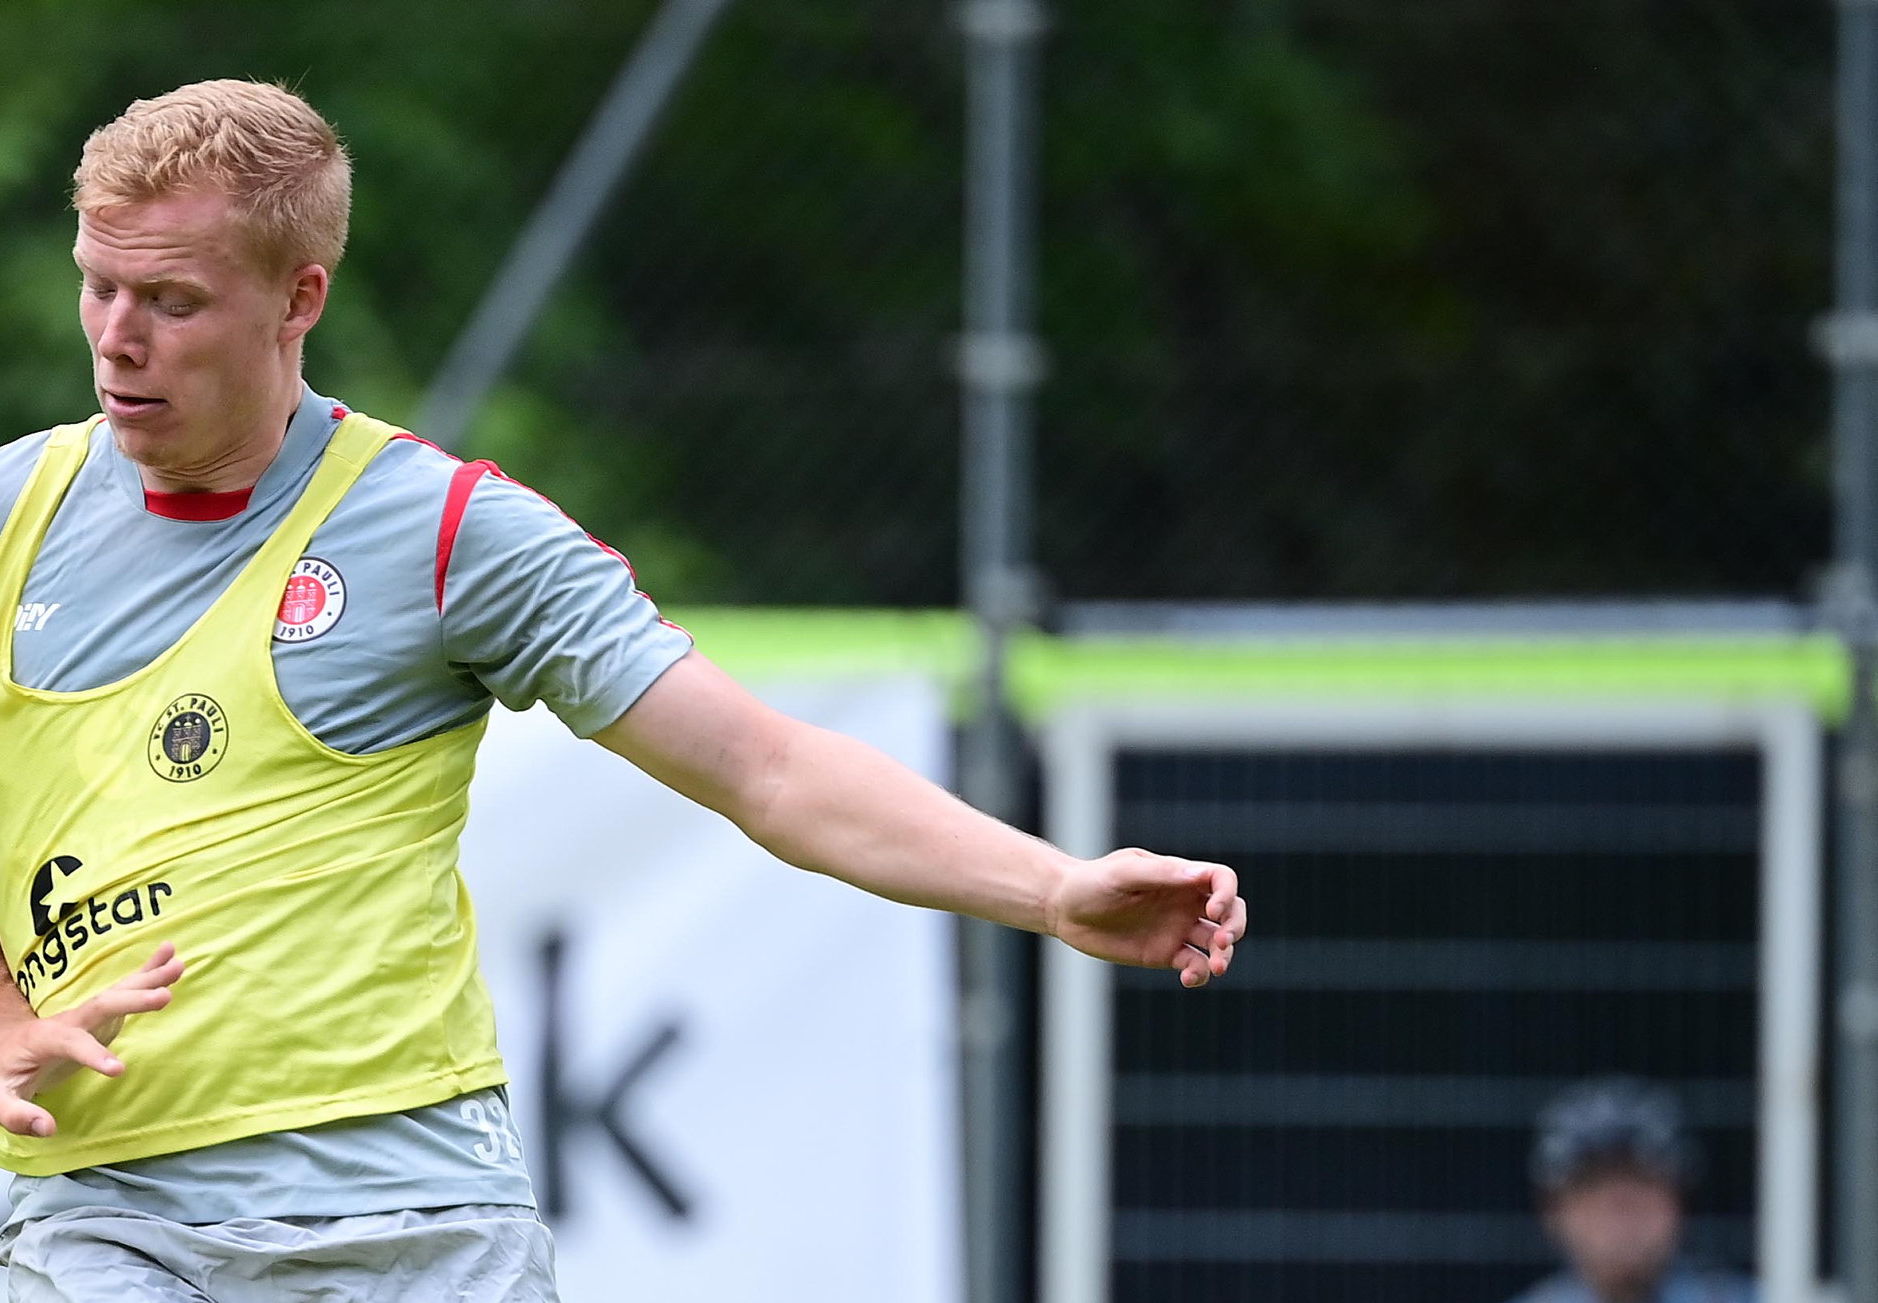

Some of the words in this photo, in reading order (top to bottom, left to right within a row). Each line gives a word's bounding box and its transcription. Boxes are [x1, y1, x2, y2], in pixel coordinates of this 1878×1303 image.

[302, 562, 340, 596] PAULI
[280, 624, 314, 638] 1910
[190, 697, 224, 733] PAULI
[168, 763, 202, 779] 1910
[16, 882, 173, 1000] ongstar
